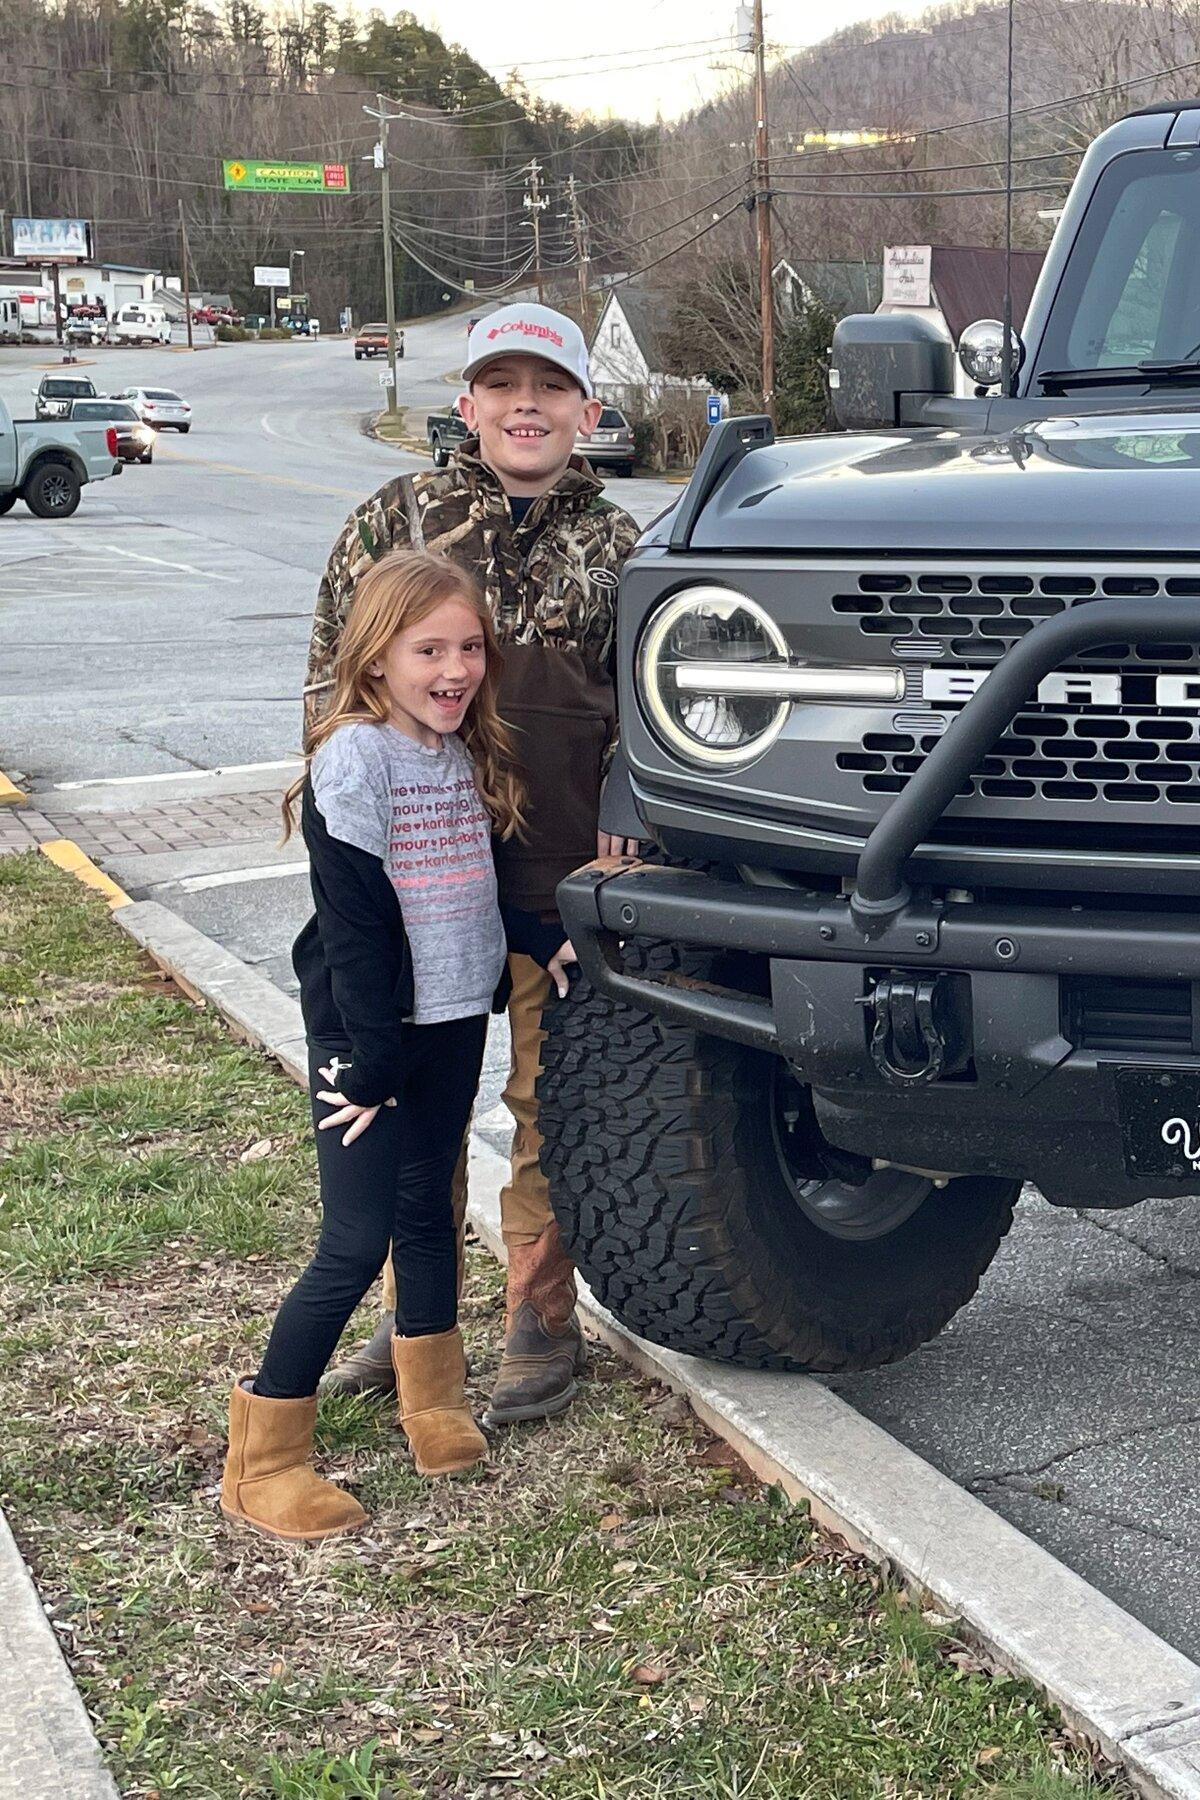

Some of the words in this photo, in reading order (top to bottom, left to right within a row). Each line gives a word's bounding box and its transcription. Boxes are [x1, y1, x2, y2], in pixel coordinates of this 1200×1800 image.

[259, 169, 315, 178] CAUTION
[254, 177, 289, 185] STATE
[500, 320, 563, 344] Columbia
